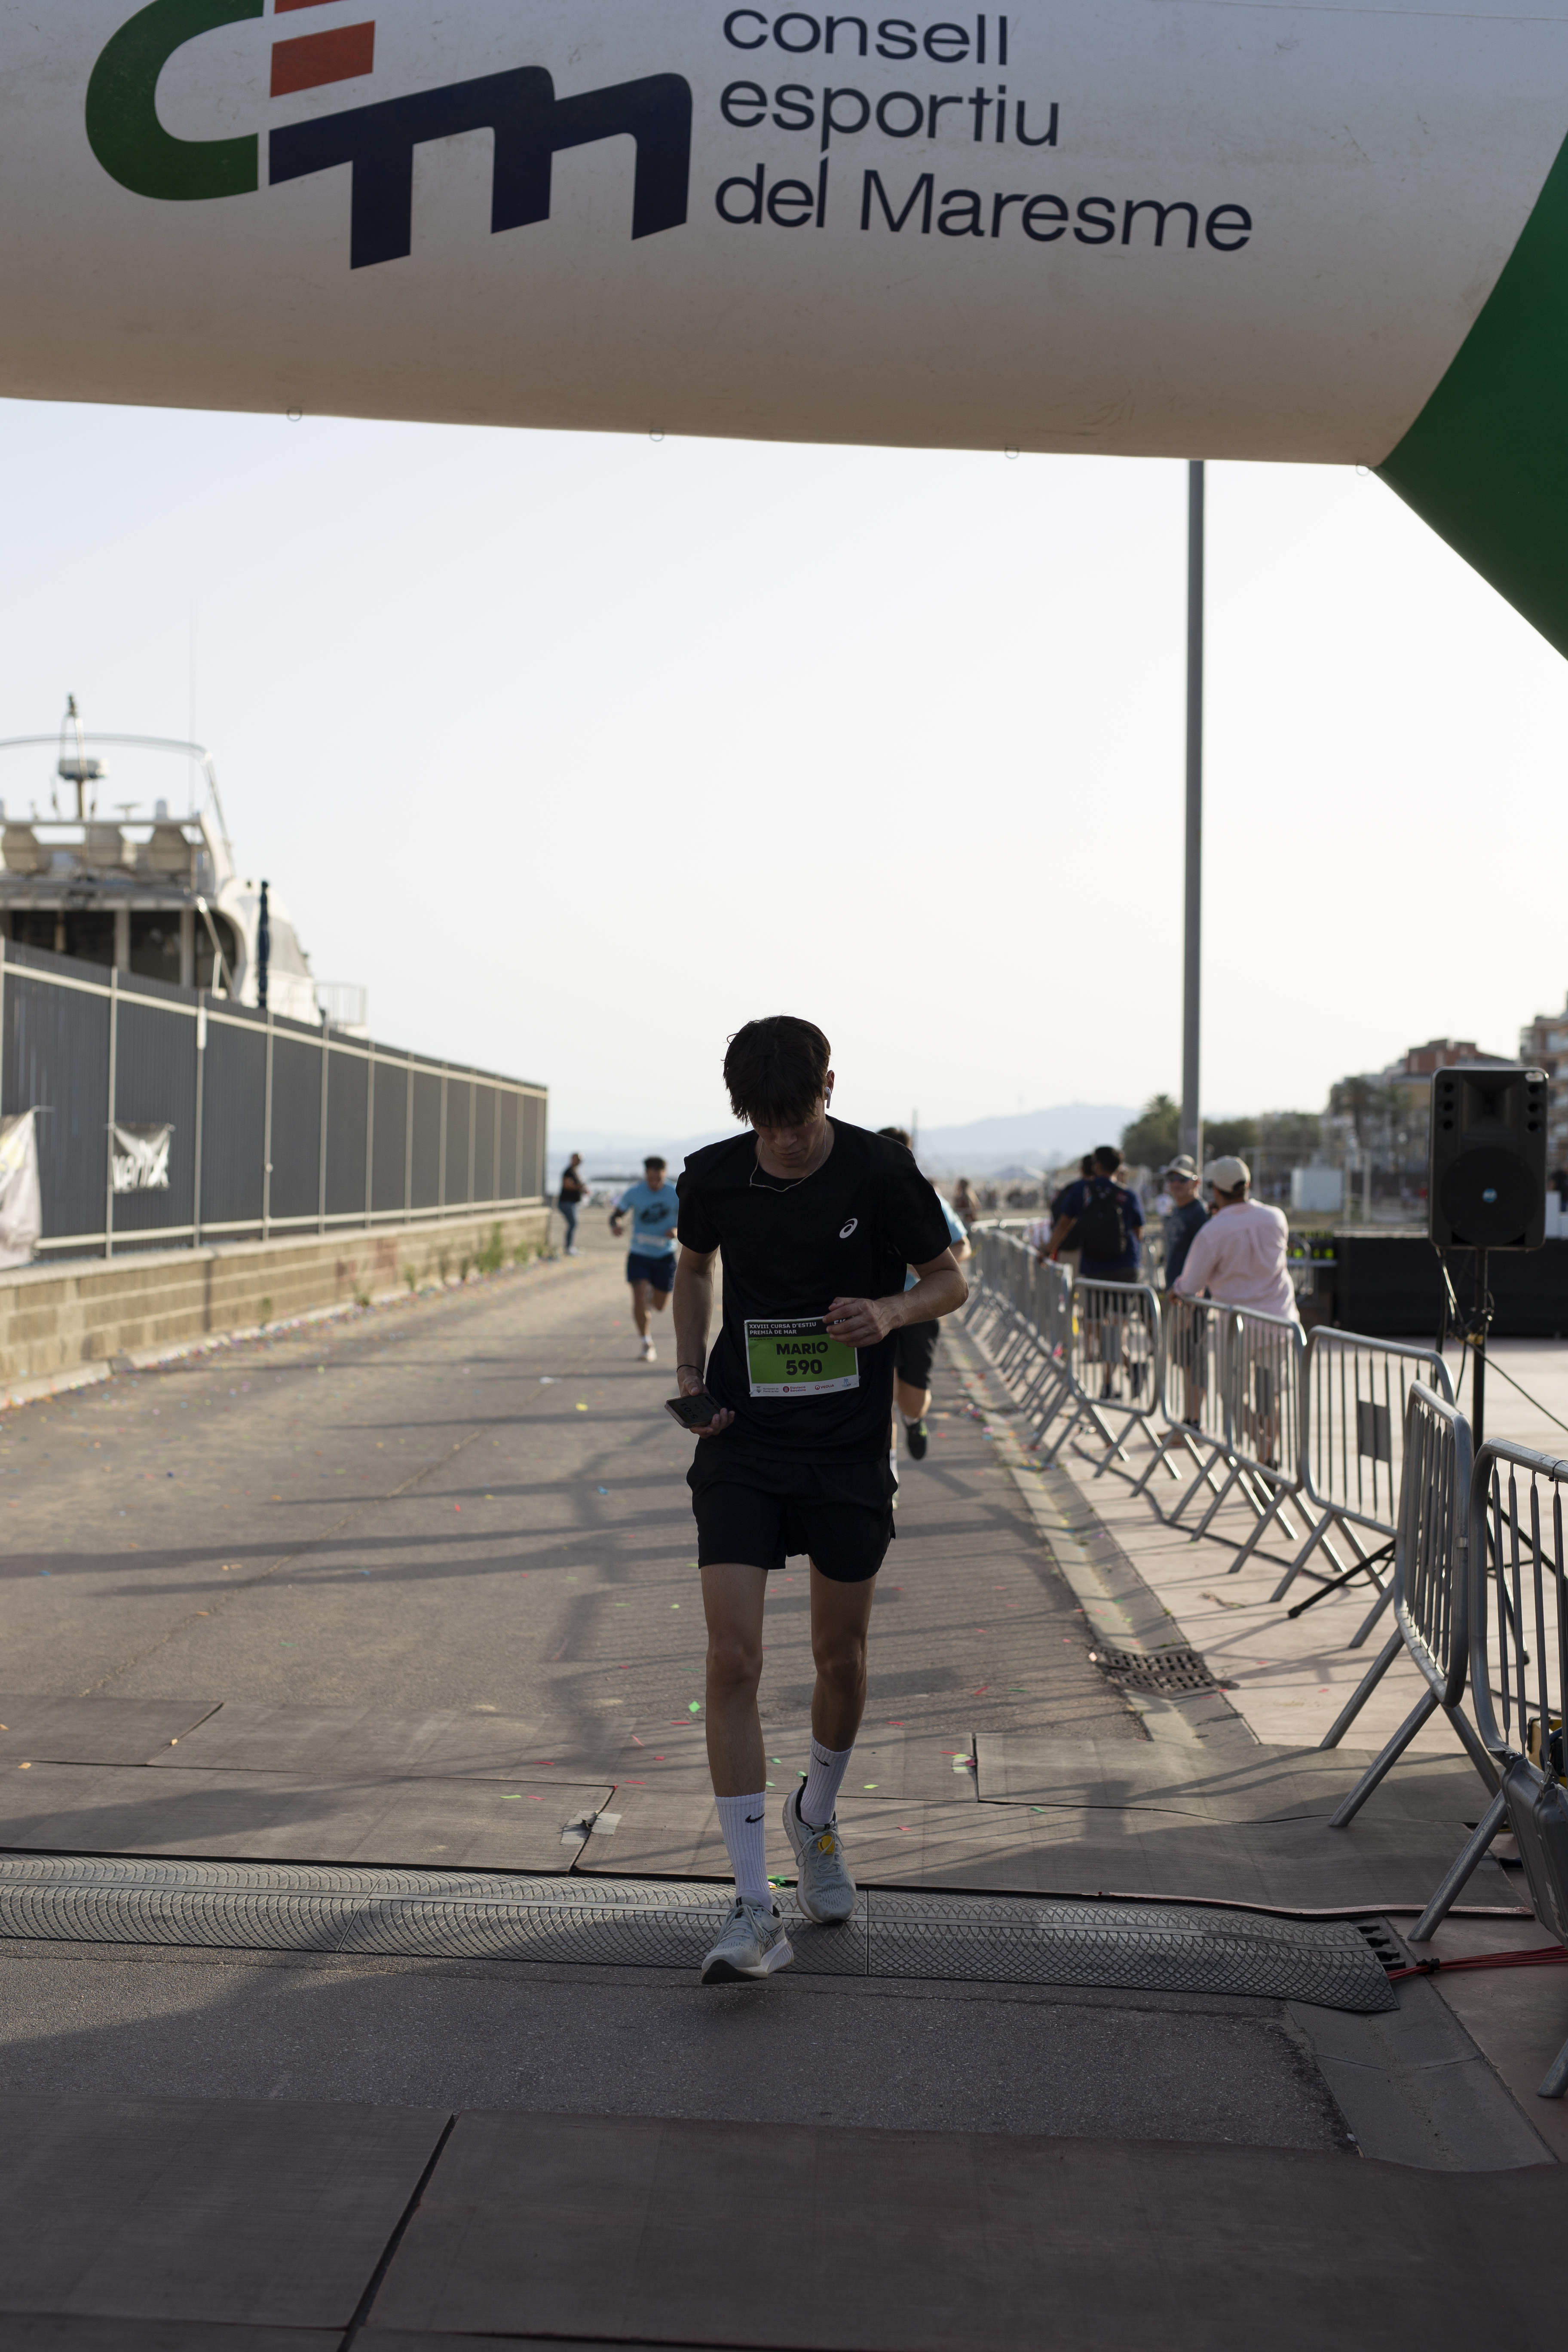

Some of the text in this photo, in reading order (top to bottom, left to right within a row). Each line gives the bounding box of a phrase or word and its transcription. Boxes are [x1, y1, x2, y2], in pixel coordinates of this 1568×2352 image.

[723, 9, 1008, 65] consell
[719, 80, 1060, 153] esportiu
[714, 156, 1252, 251] del Maresme
[776, 1341, 828, 1355] MARIO
[786, 1359, 823, 1375] 590
